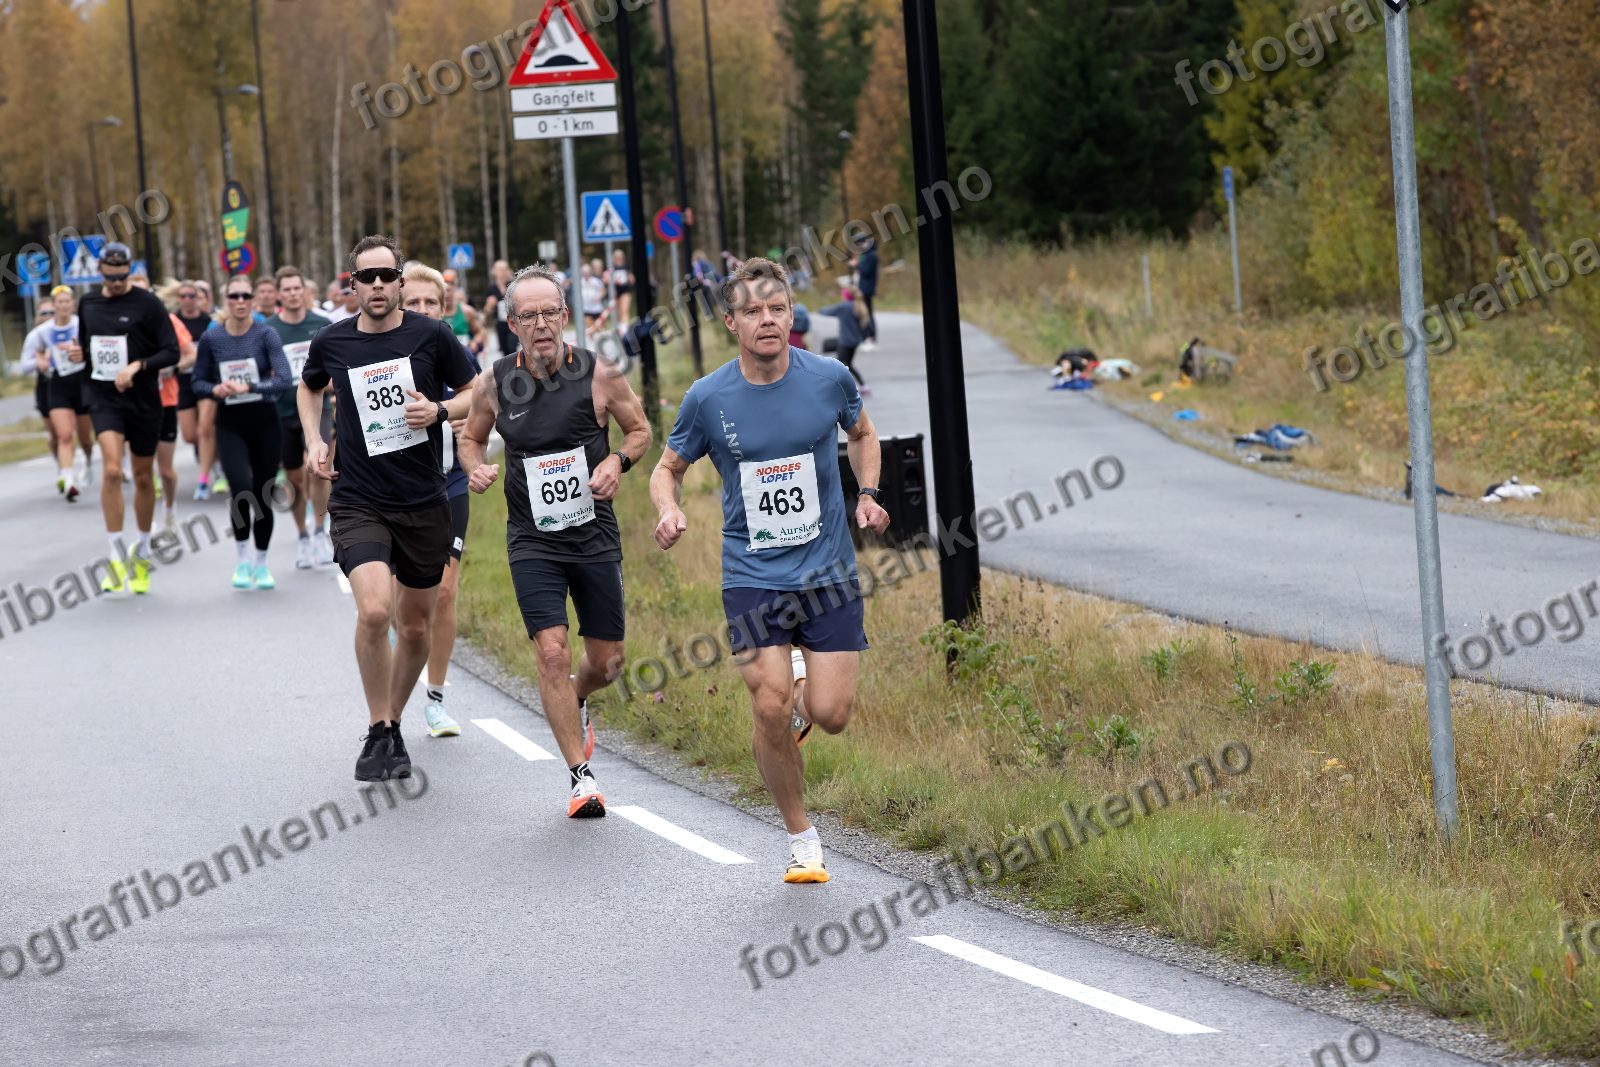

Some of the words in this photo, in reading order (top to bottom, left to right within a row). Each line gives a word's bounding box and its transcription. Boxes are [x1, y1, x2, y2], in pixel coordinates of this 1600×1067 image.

[533, 90, 595, 107] Gangfelt
[97, 351, 120, 365] 908
[363, 364, 400, 379] NORGES
[367, 372, 395, 385] LØPET
[366, 384, 405, 411] 383
[537, 455, 576, 470] NORGES
[543, 464, 572, 476] LØPET
[755, 462, 802, 477] NORGES
[761, 471, 796, 484] LØPET
[541, 476, 582, 505] 692
[758, 486, 805, 516] 463
[561, 505, 593, 520] Aurskog
